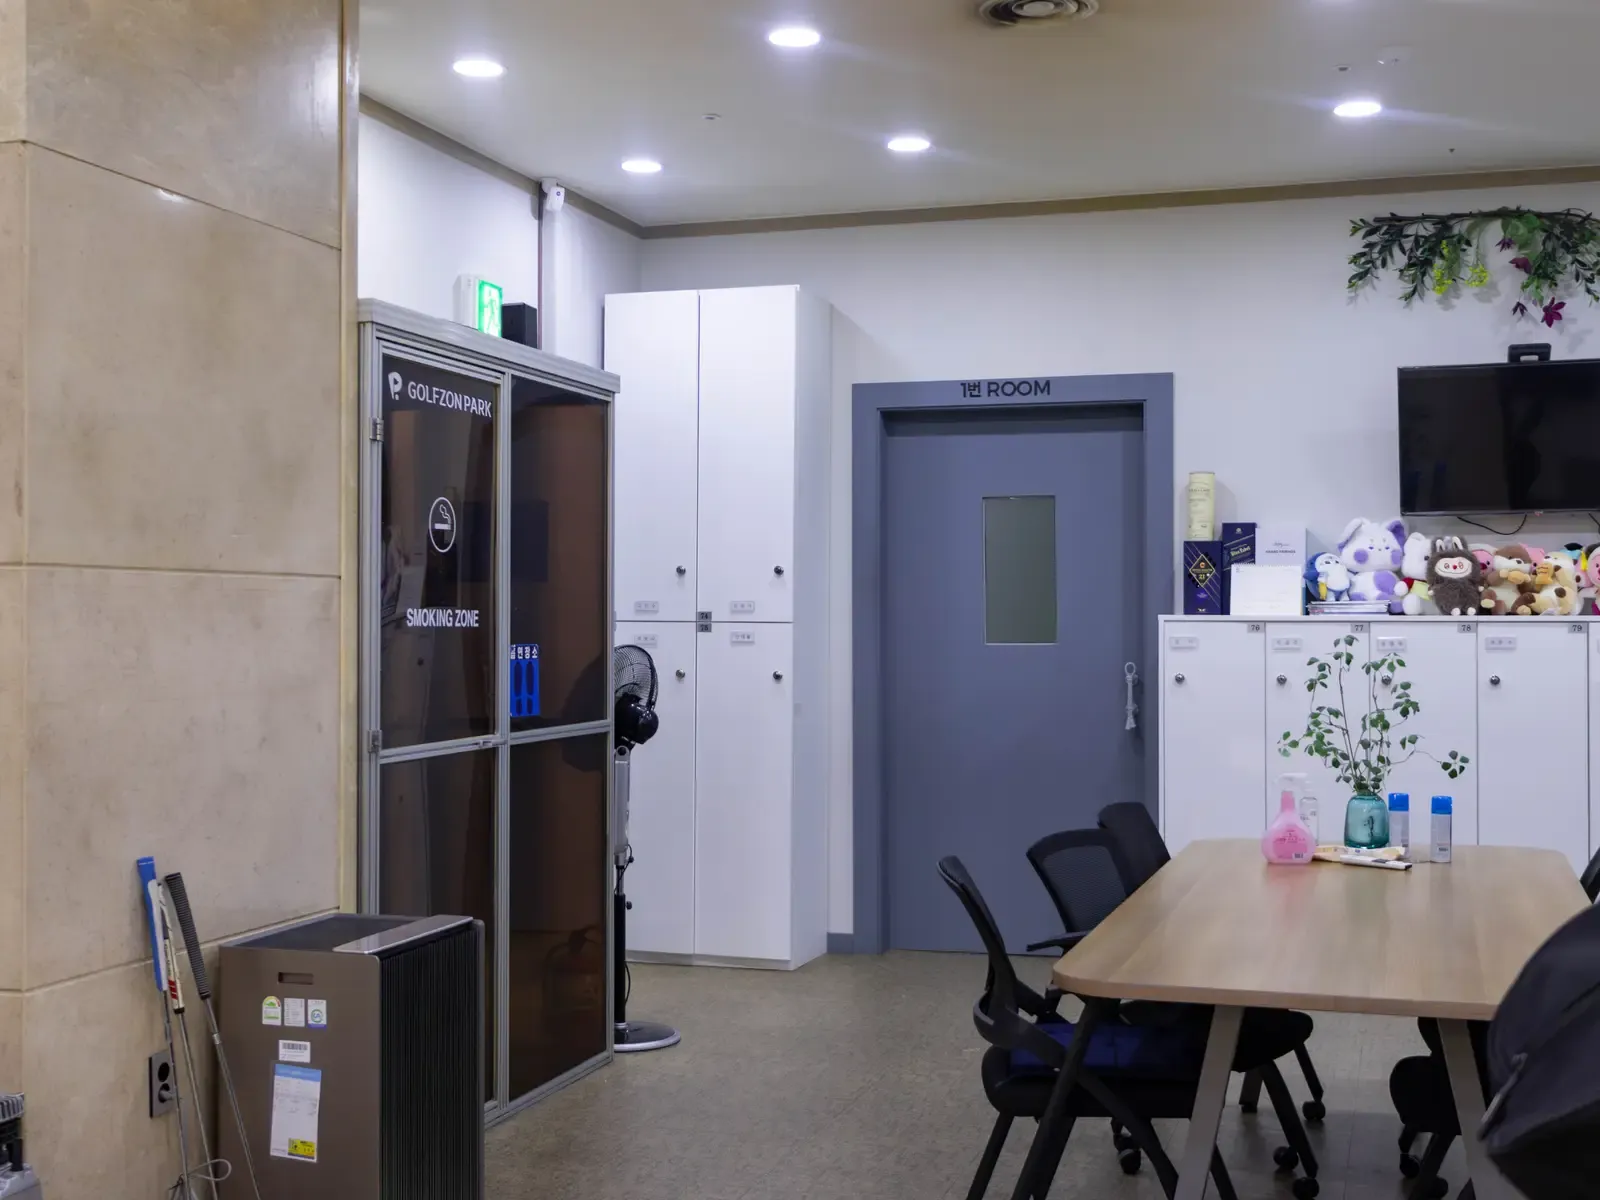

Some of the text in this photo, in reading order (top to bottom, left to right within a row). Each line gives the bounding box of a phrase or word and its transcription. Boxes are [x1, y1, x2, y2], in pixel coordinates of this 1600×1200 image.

[960, 379, 1051, 398] 1번 ROOM
[406, 608, 480, 628] SMOKING ZONE
[700, 612, 708, 620] 74
[1251, 624, 1260, 632] 76
[1354, 624, 1364, 632] 77
[1461, 624, 1472, 632] 78
[1571, 624, 1583, 632] 79
